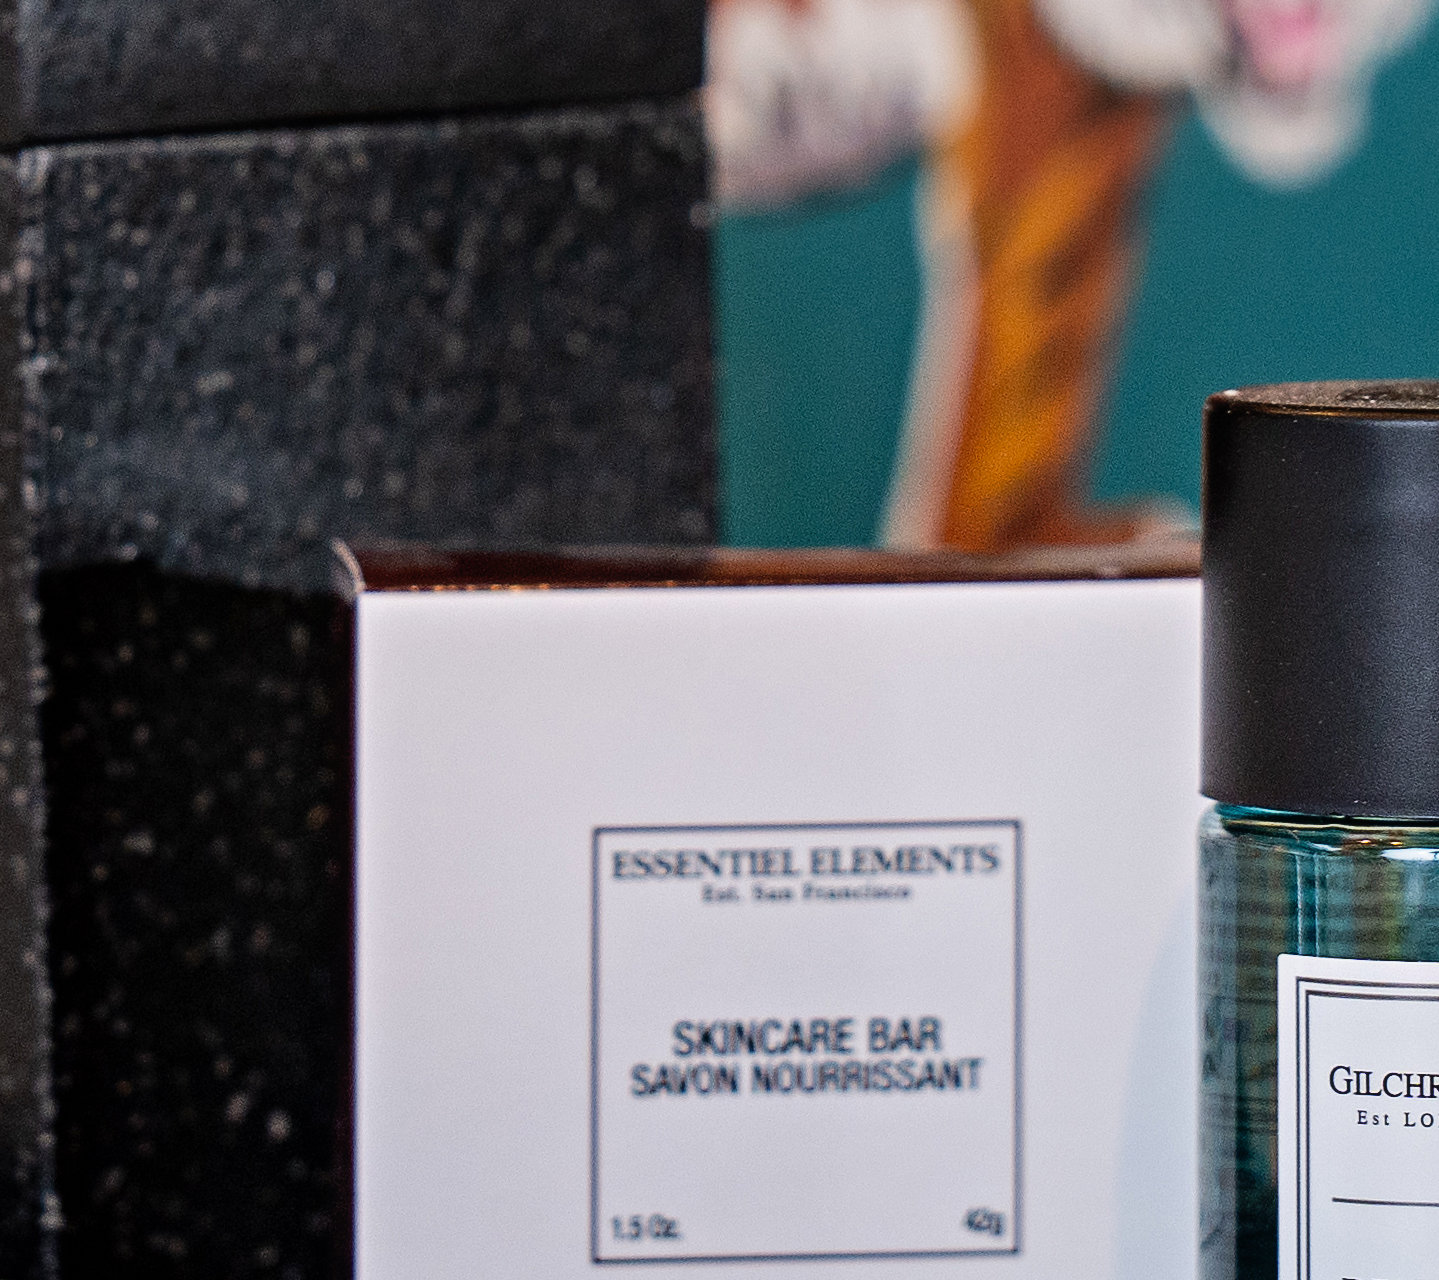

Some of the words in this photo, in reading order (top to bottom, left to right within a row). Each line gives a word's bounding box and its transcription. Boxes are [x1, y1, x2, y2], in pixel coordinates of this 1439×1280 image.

[611, 848, 801, 881] ESSENTIEL
[808, 844, 1002, 879] ELEMENTS
[701, 883, 741, 905] Est.
[751, 882, 796, 904] San
[672, 1017, 854, 1059] SKINCARE
[867, 1016, 942, 1055] BAR
[630, 1062, 741, 1099] SAVON
[750, 1057, 983, 1096] NOURRISSANT
[1356, 1108, 1391, 1127] Est
